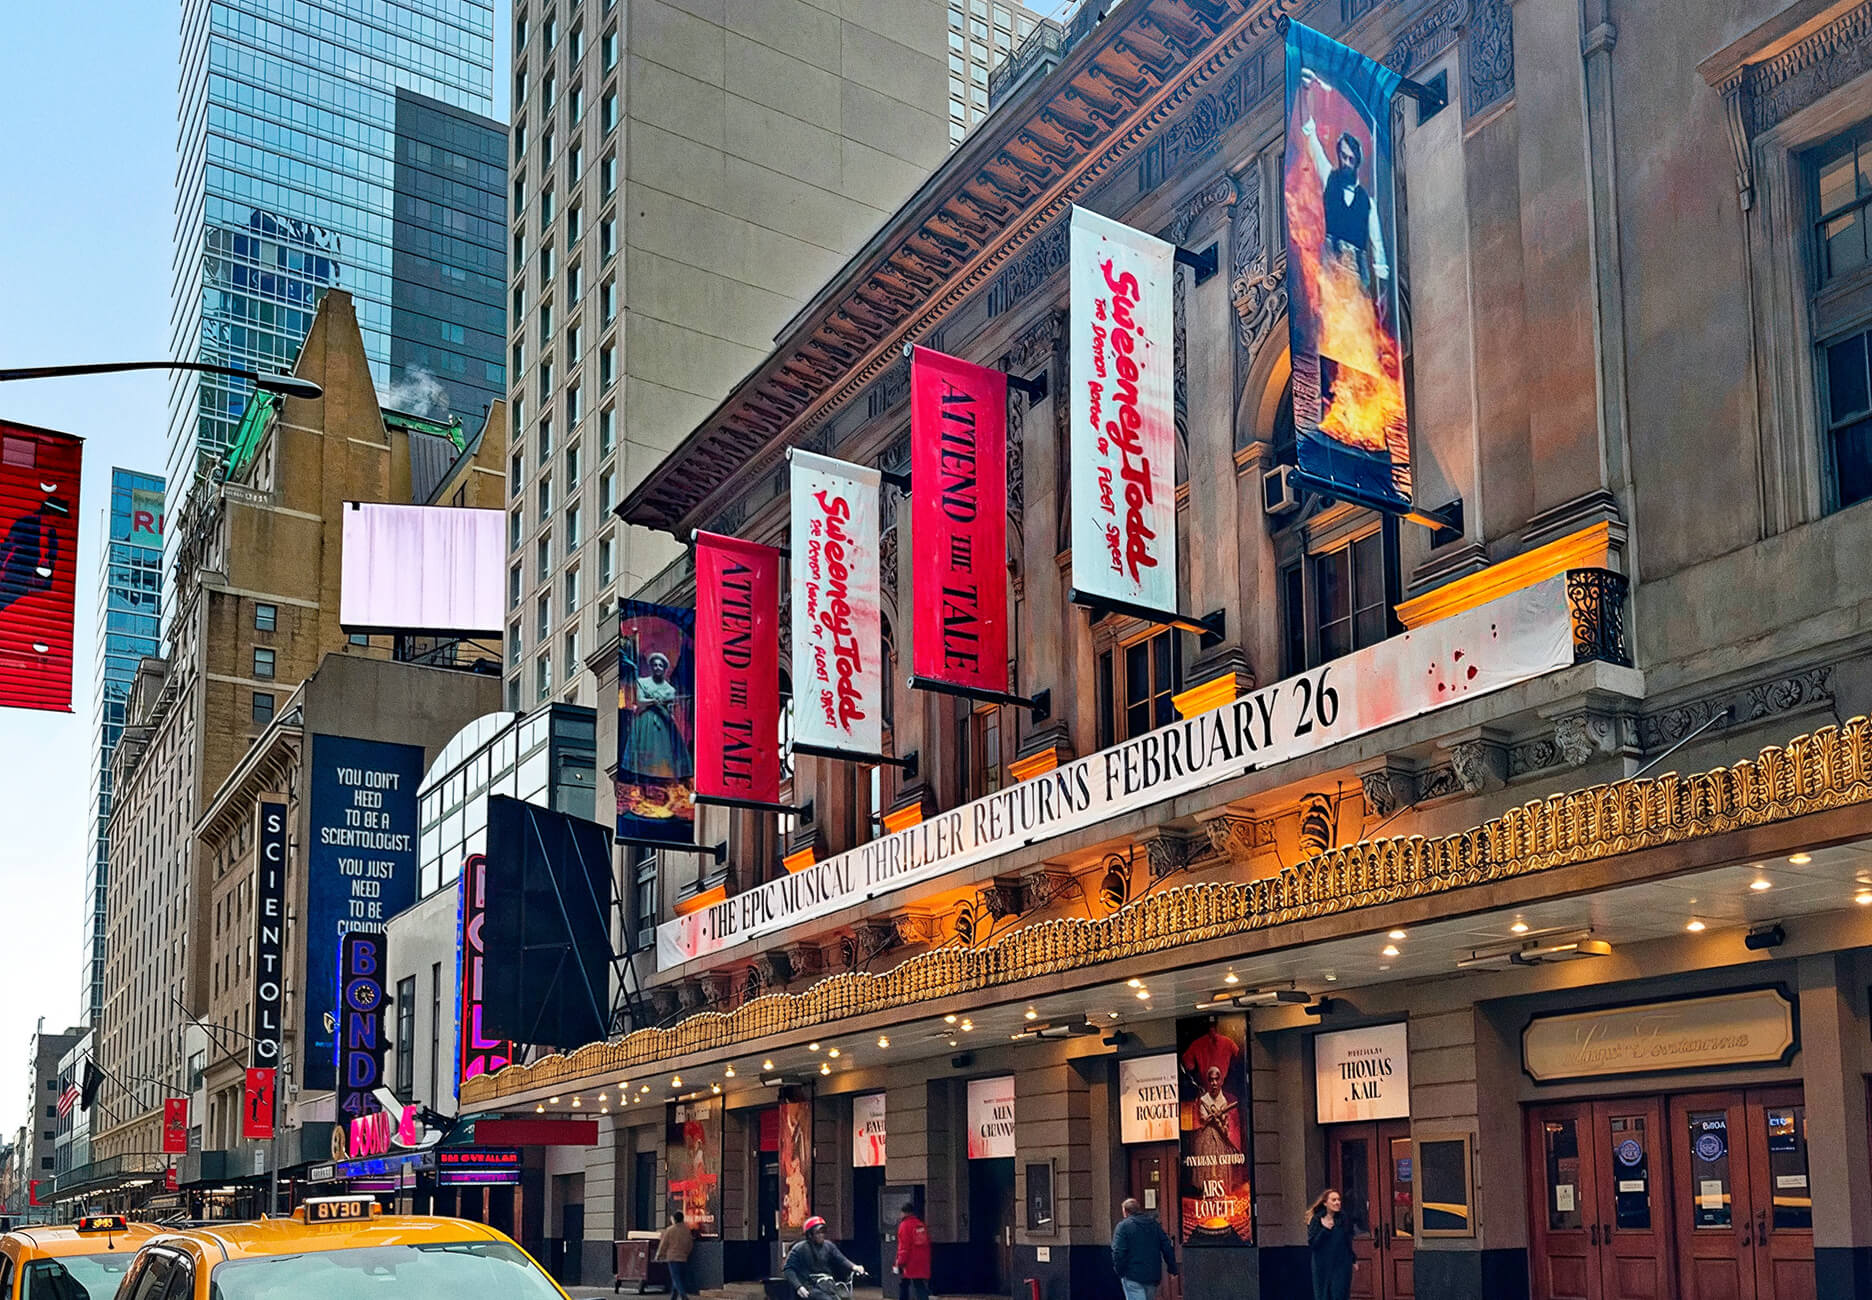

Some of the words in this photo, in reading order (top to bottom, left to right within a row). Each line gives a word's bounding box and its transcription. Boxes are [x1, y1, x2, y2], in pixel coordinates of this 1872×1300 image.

[1100, 258, 1143, 456] Sweeney
[941, 378, 977, 524] ATTEND
[1121, 455, 1158, 583] Todd
[950, 534, 972, 574] THE
[722, 555, 753, 670] ATTEND
[812, 490, 851, 637] Sweeney
[835, 633, 866, 734] Todd
[942, 584, 979, 674] TALE
[730, 679, 748, 710] THE
[722, 719, 753, 790] TALE
[336, 767, 362, 786] YOU
[365, 770, 400, 790] DON'T
[709, 900, 738, 940] THE
[742, 884, 776, 929] EPIC
[781, 855, 857, 917] MUSICAL
[861, 811, 964, 887] THRILLER
[973, 763, 1091, 848] RETURNS
[1103, 688, 1280, 802] FEBRUARY
[1292, 666, 1340, 739] 26
[345, 808, 361, 827] TO
[381, 812, 390, 829] A
[321, 827, 412, 852] SCIENTOLOGIST.
[338, 857, 362, 876] YOU
[366, 860, 395, 879] JUST
[352, 879, 380, 898] NEED
[348, 899, 364, 919] TO
[368, 902, 383, 919] BE
[346, 940, 382, 1088] BOND
[1338, 1057, 1393, 1080] THOMAS
[1138, 1083, 1178, 1102] STEVEN
[1351, 1080, 1382, 1101] KAIL
[318, 1202, 361, 1218] 8Y30
[1195, 1199, 1235, 1219] LOVETT
